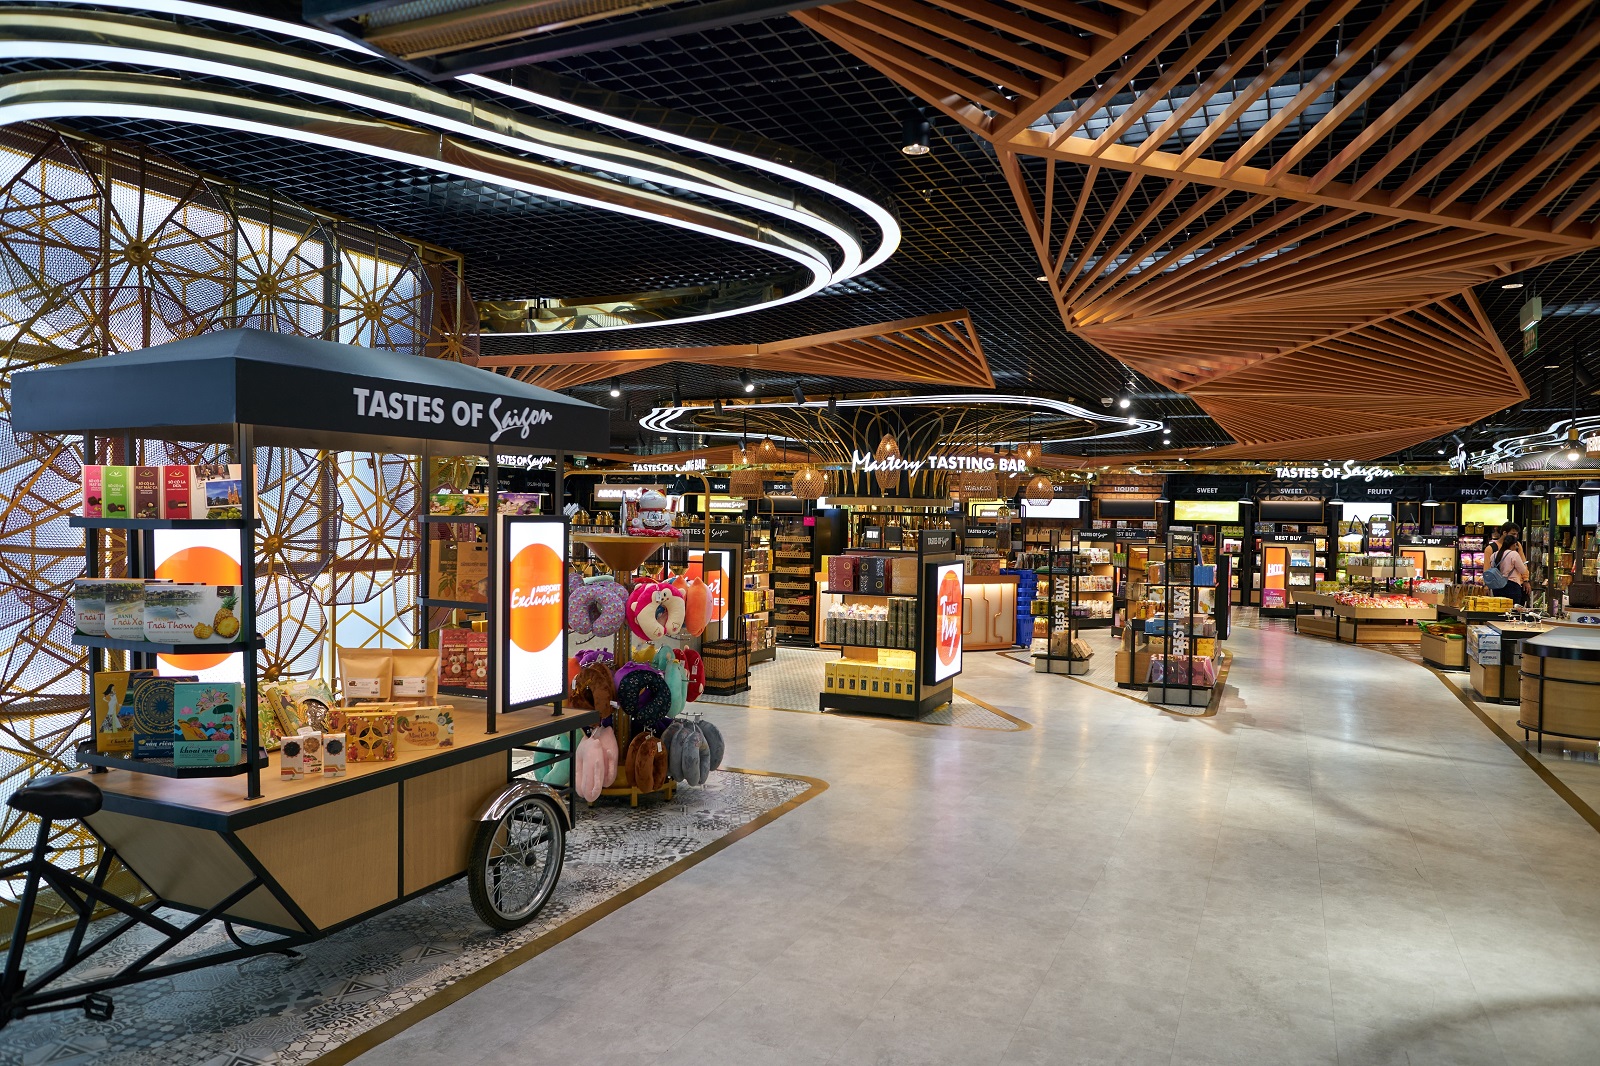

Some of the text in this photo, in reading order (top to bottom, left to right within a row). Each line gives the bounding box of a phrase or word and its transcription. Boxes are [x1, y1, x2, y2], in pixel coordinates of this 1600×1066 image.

[353, 388, 553, 442] TASTES OF Saigon
[526, 454, 552, 471] Saigon
[632, 464, 660, 472] TASTES
[660, 464, 674, 472] OF
[851, 450, 1026, 477] Mastery TASTING BAR
[1276, 458, 1394, 482] TASTES OF Saigon
[510, 587, 561, 609] Exclusive
[536, 584, 562, 593] AIRPORT
[946, 603, 958, 615] MUST
[1055, 577, 1065, 633] BEST BUY
[1173, 588, 1185, 656] BEST BUY
